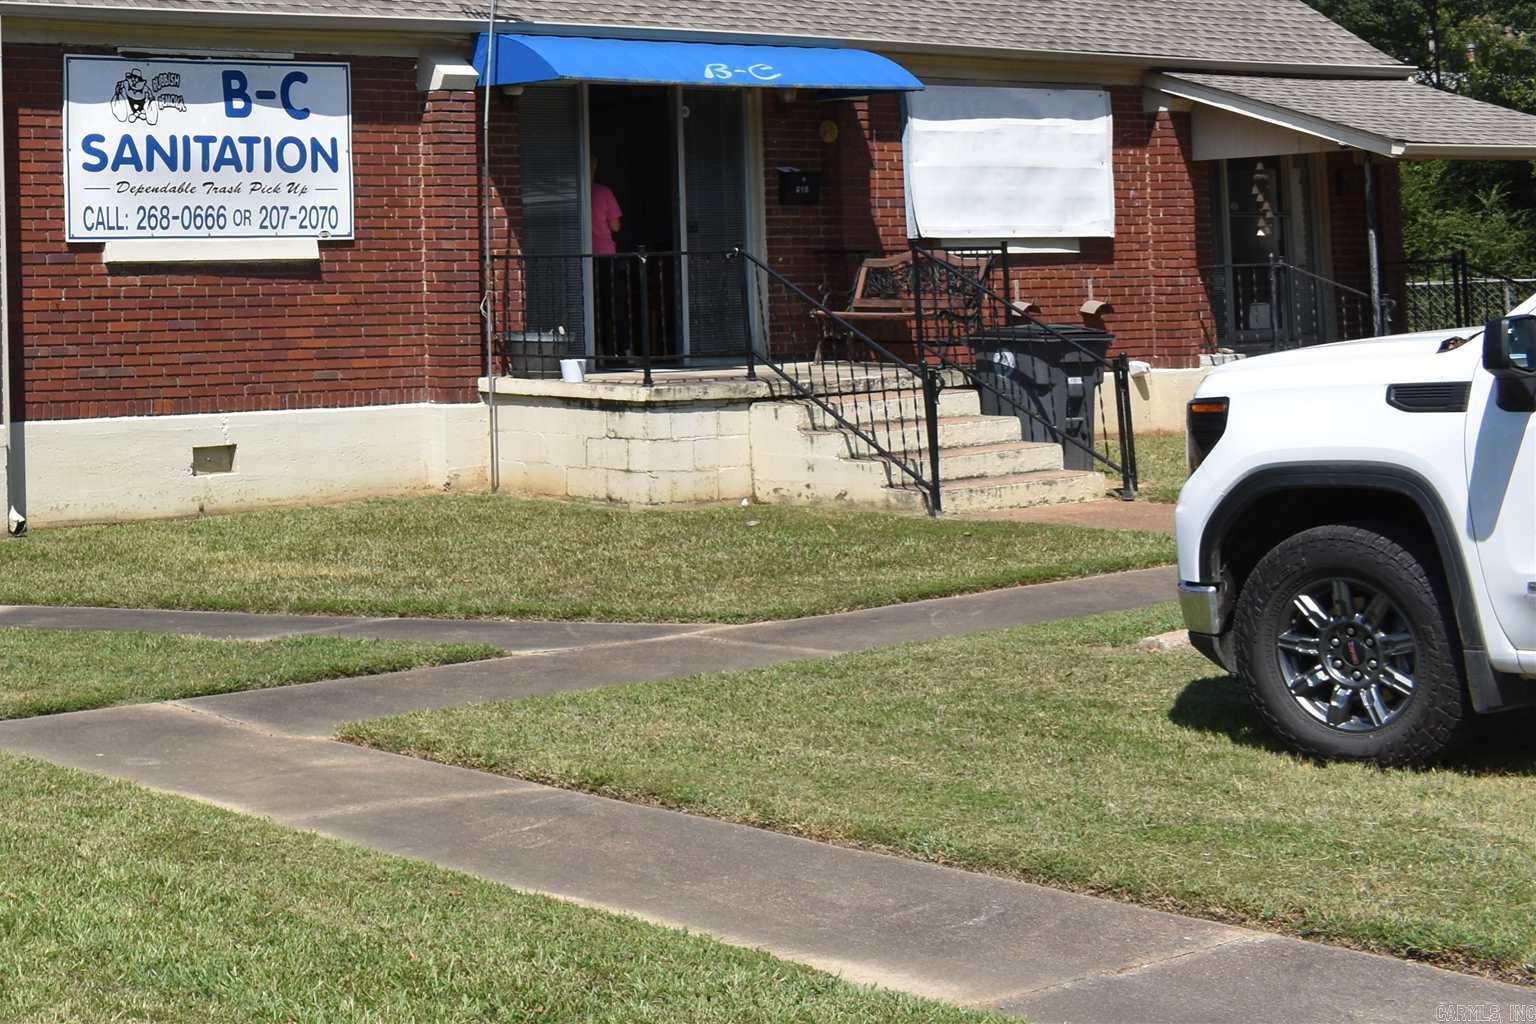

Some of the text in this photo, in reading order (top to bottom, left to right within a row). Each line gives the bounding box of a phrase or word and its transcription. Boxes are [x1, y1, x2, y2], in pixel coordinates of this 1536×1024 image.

[221, 69, 311, 120] B-C
[81, 133, 339, 173] SANITATION
[115, 181, 310, 196] Dependable Trash Pick Up
[82, 205, 339, 231] CALL: 268-0666 OR 207-2070
